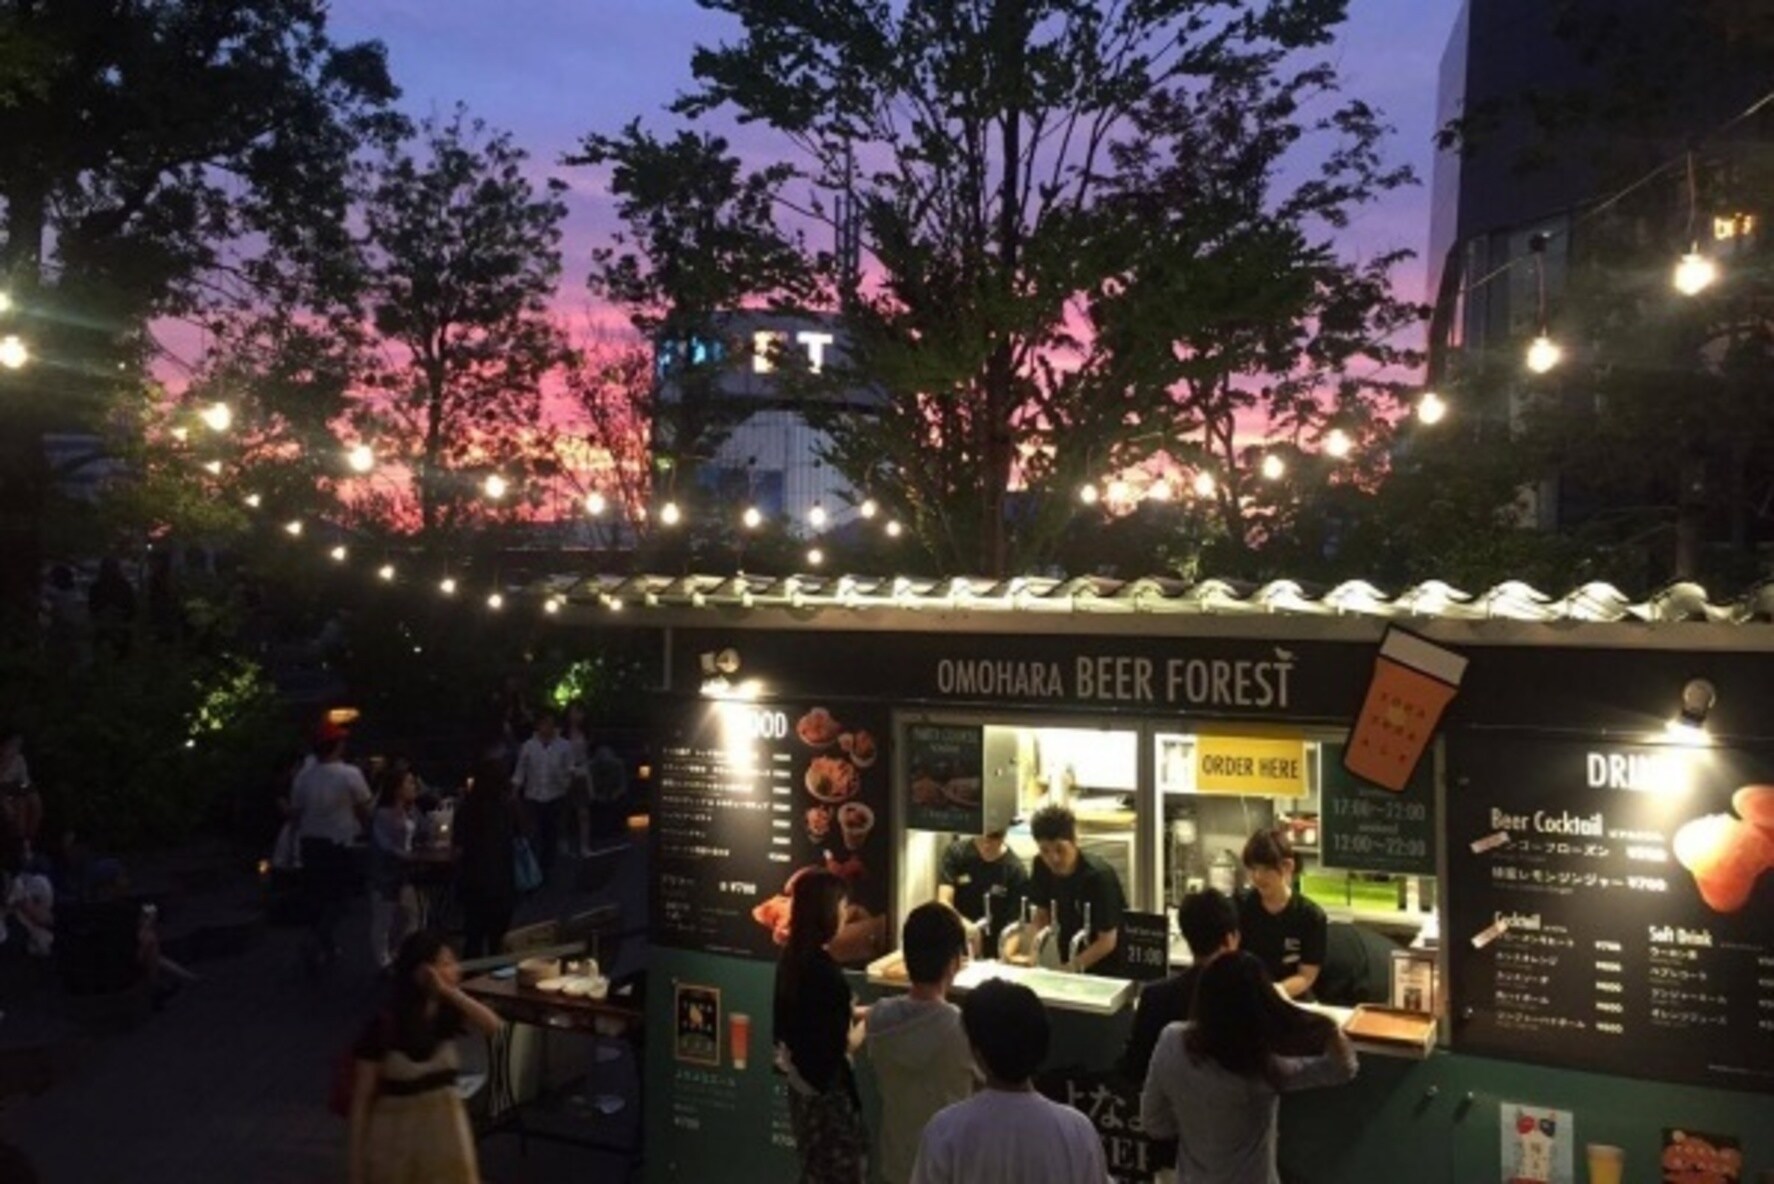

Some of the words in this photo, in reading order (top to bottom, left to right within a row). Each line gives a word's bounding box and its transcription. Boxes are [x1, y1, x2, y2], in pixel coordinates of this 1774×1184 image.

[937, 659, 1064, 697] OMOHARA
[1075, 656, 1154, 700] BEER
[1166, 659, 1295, 707] FOREST
[1202, 754, 1255, 776] ORDER
[1259, 755, 1300, 780] HERE
[1491, 808, 1529, 831] Beer
[1534, 810, 1604, 836] Cocktail
[1649, 925, 1674, 942] Soft
